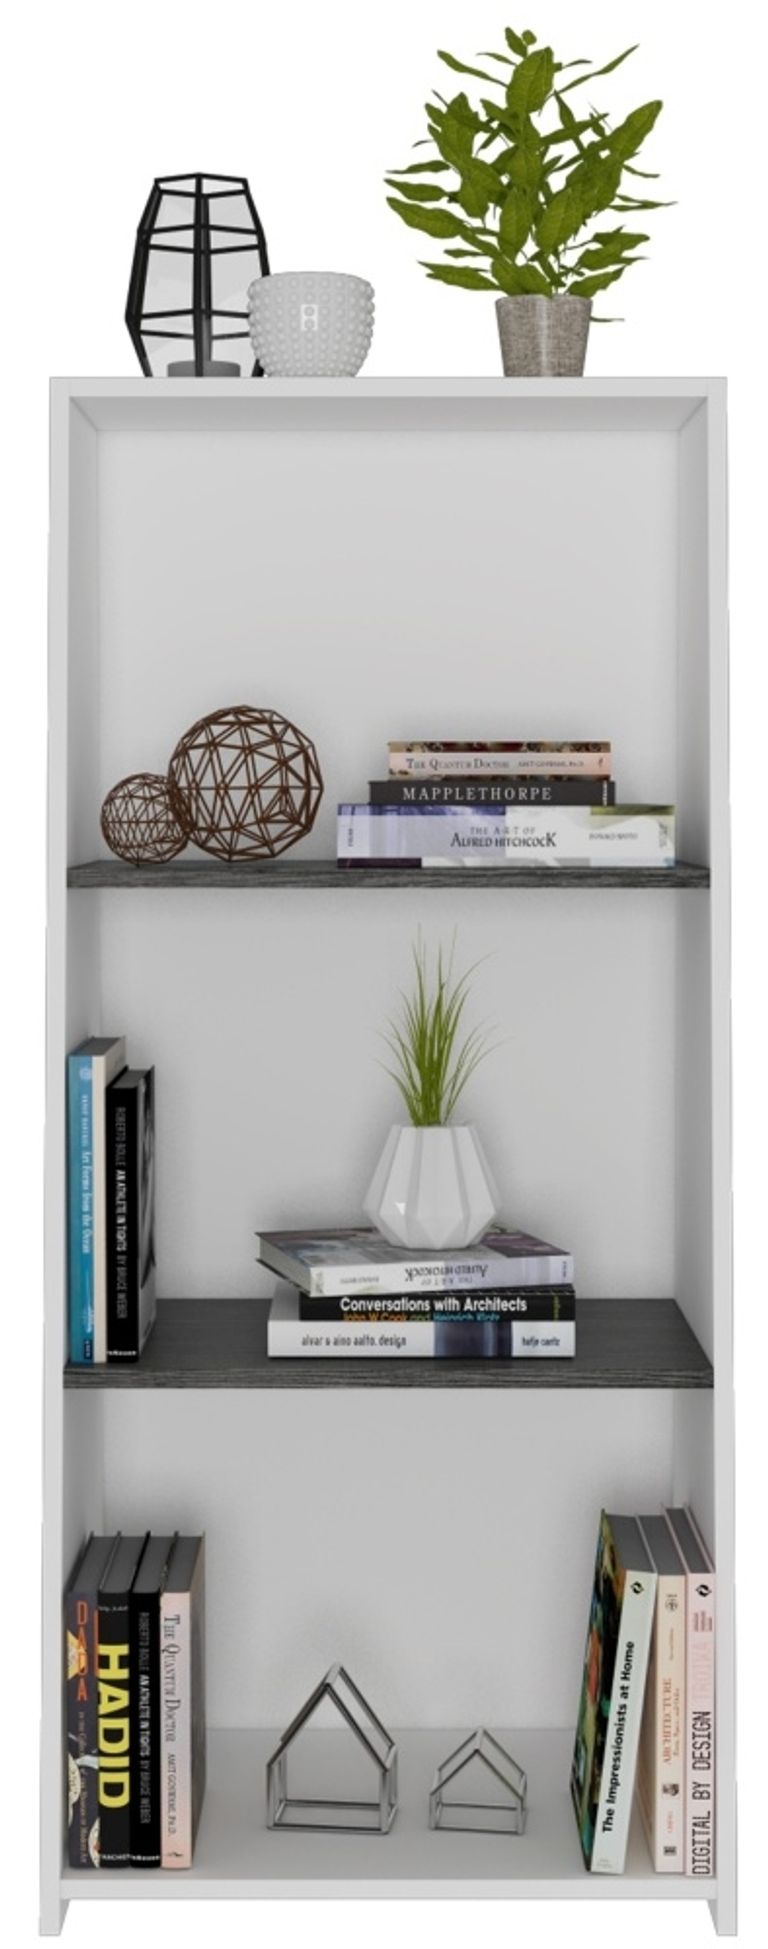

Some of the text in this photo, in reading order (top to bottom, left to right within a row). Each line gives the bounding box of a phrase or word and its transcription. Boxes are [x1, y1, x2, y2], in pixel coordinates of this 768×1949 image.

[402, 786, 553, 801] MAPPLETHORPE
[450, 832, 558, 848] ALFRED HITCHCOCK
[469, 826, 492, 836] THE
[116, 1169, 127, 1181] AN
[116, 1181, 127, 1214] ATHLETE
[116, 1215, 127, 1225] IN
[116, 1225, 127, 1251] TIGHTS
[339, 1296, 528, 1312] Conversations with Architects
[301, 1334, 324, 1347] alvar
[333, 1335, 351, 1346] aino
[378, 1334, 407, 1349] design
[76, 1600, 88, 1702] DADA
[139, 1674, 151, 1686] AN
[139, 1686, 151, 1719] ATHLETE
[98, 1643, 130, 1809] HADID
[139, 1719, 151, 1730] IN
[662, 1677, 672, 1766] ARCHITECTURE
[139, 1730, 151, 1757] TIGHTS
[602, 1640, 635, 1833] The Impressionists at Home
[692, 1710, 711, 1876] DIGITAL BY DESIGN
